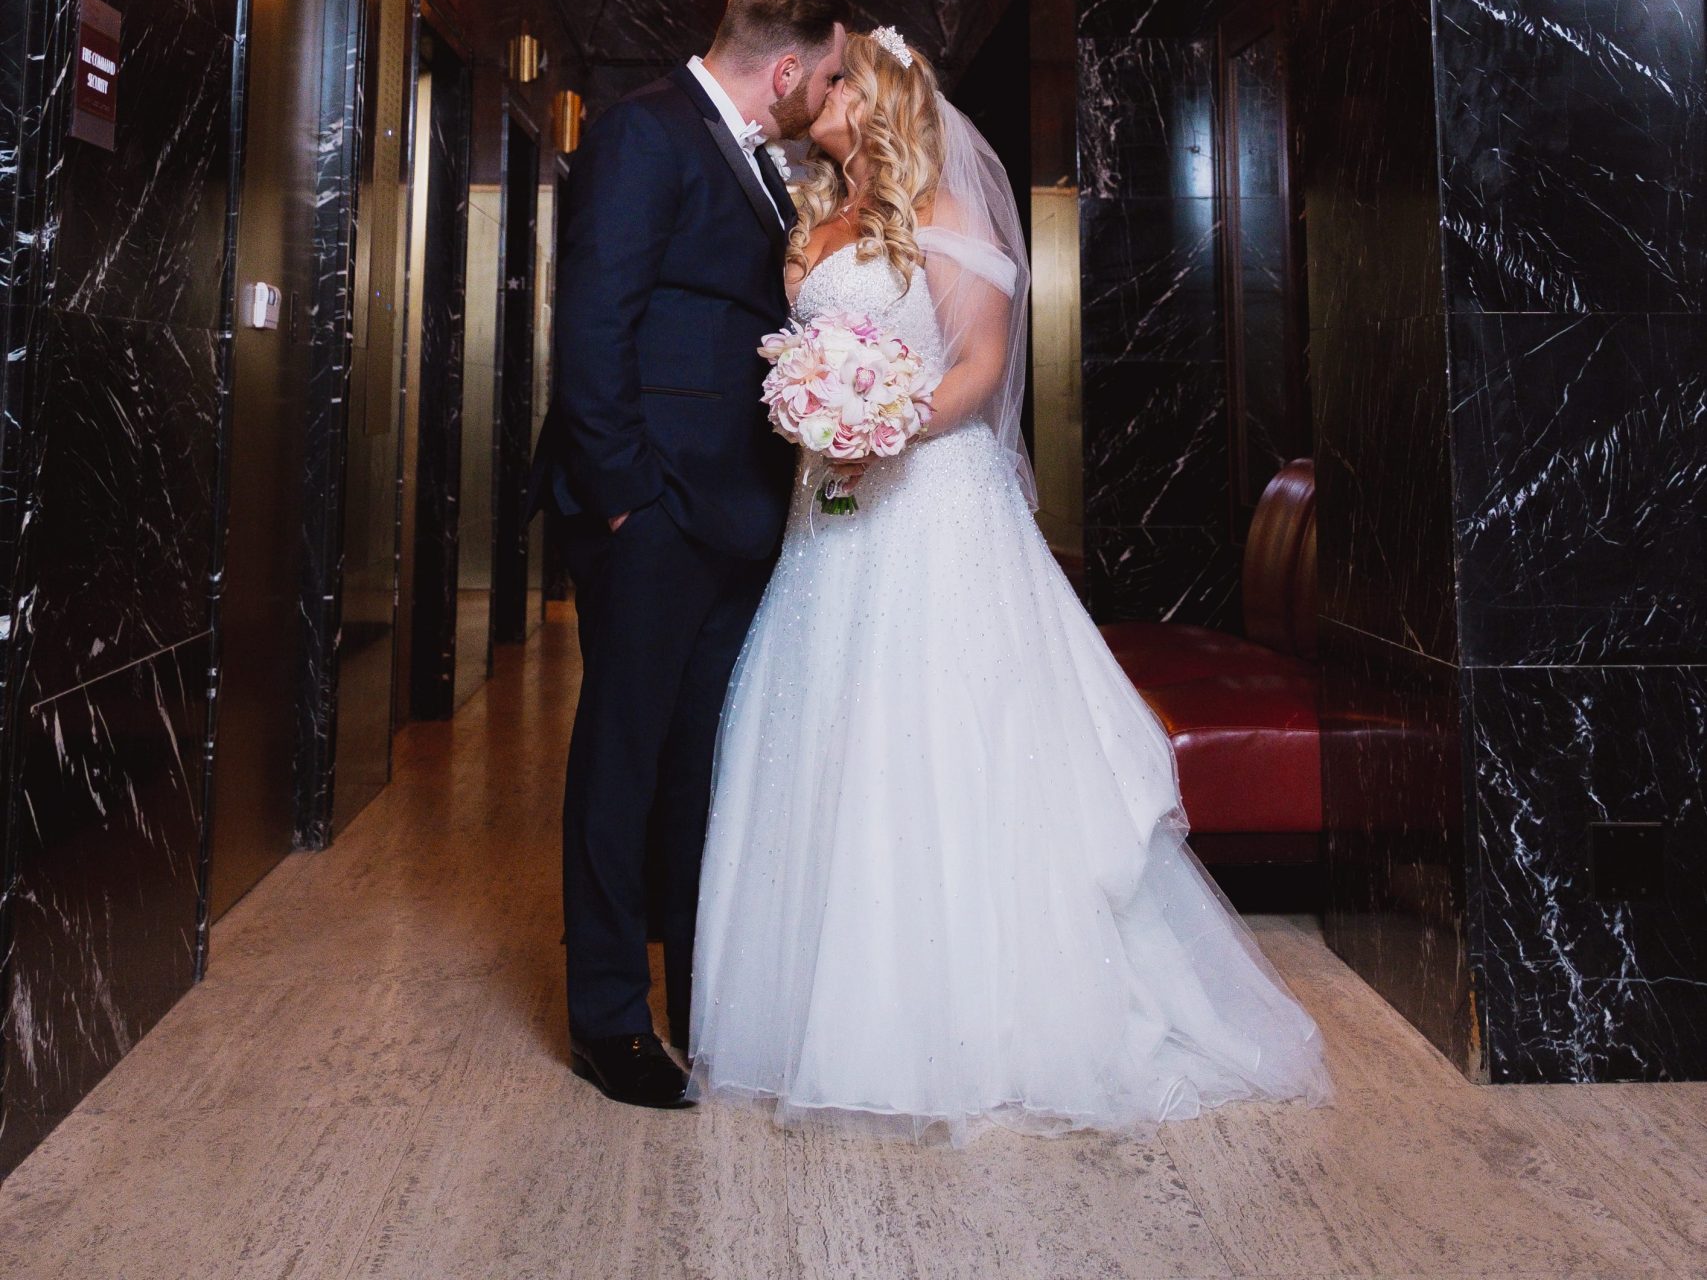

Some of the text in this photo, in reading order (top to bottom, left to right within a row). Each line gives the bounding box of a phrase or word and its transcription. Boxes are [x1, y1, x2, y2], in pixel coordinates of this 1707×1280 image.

[82, 46, 116, 76] FIRE COMMAND
[87, 72, 108, 94] SECURITY
